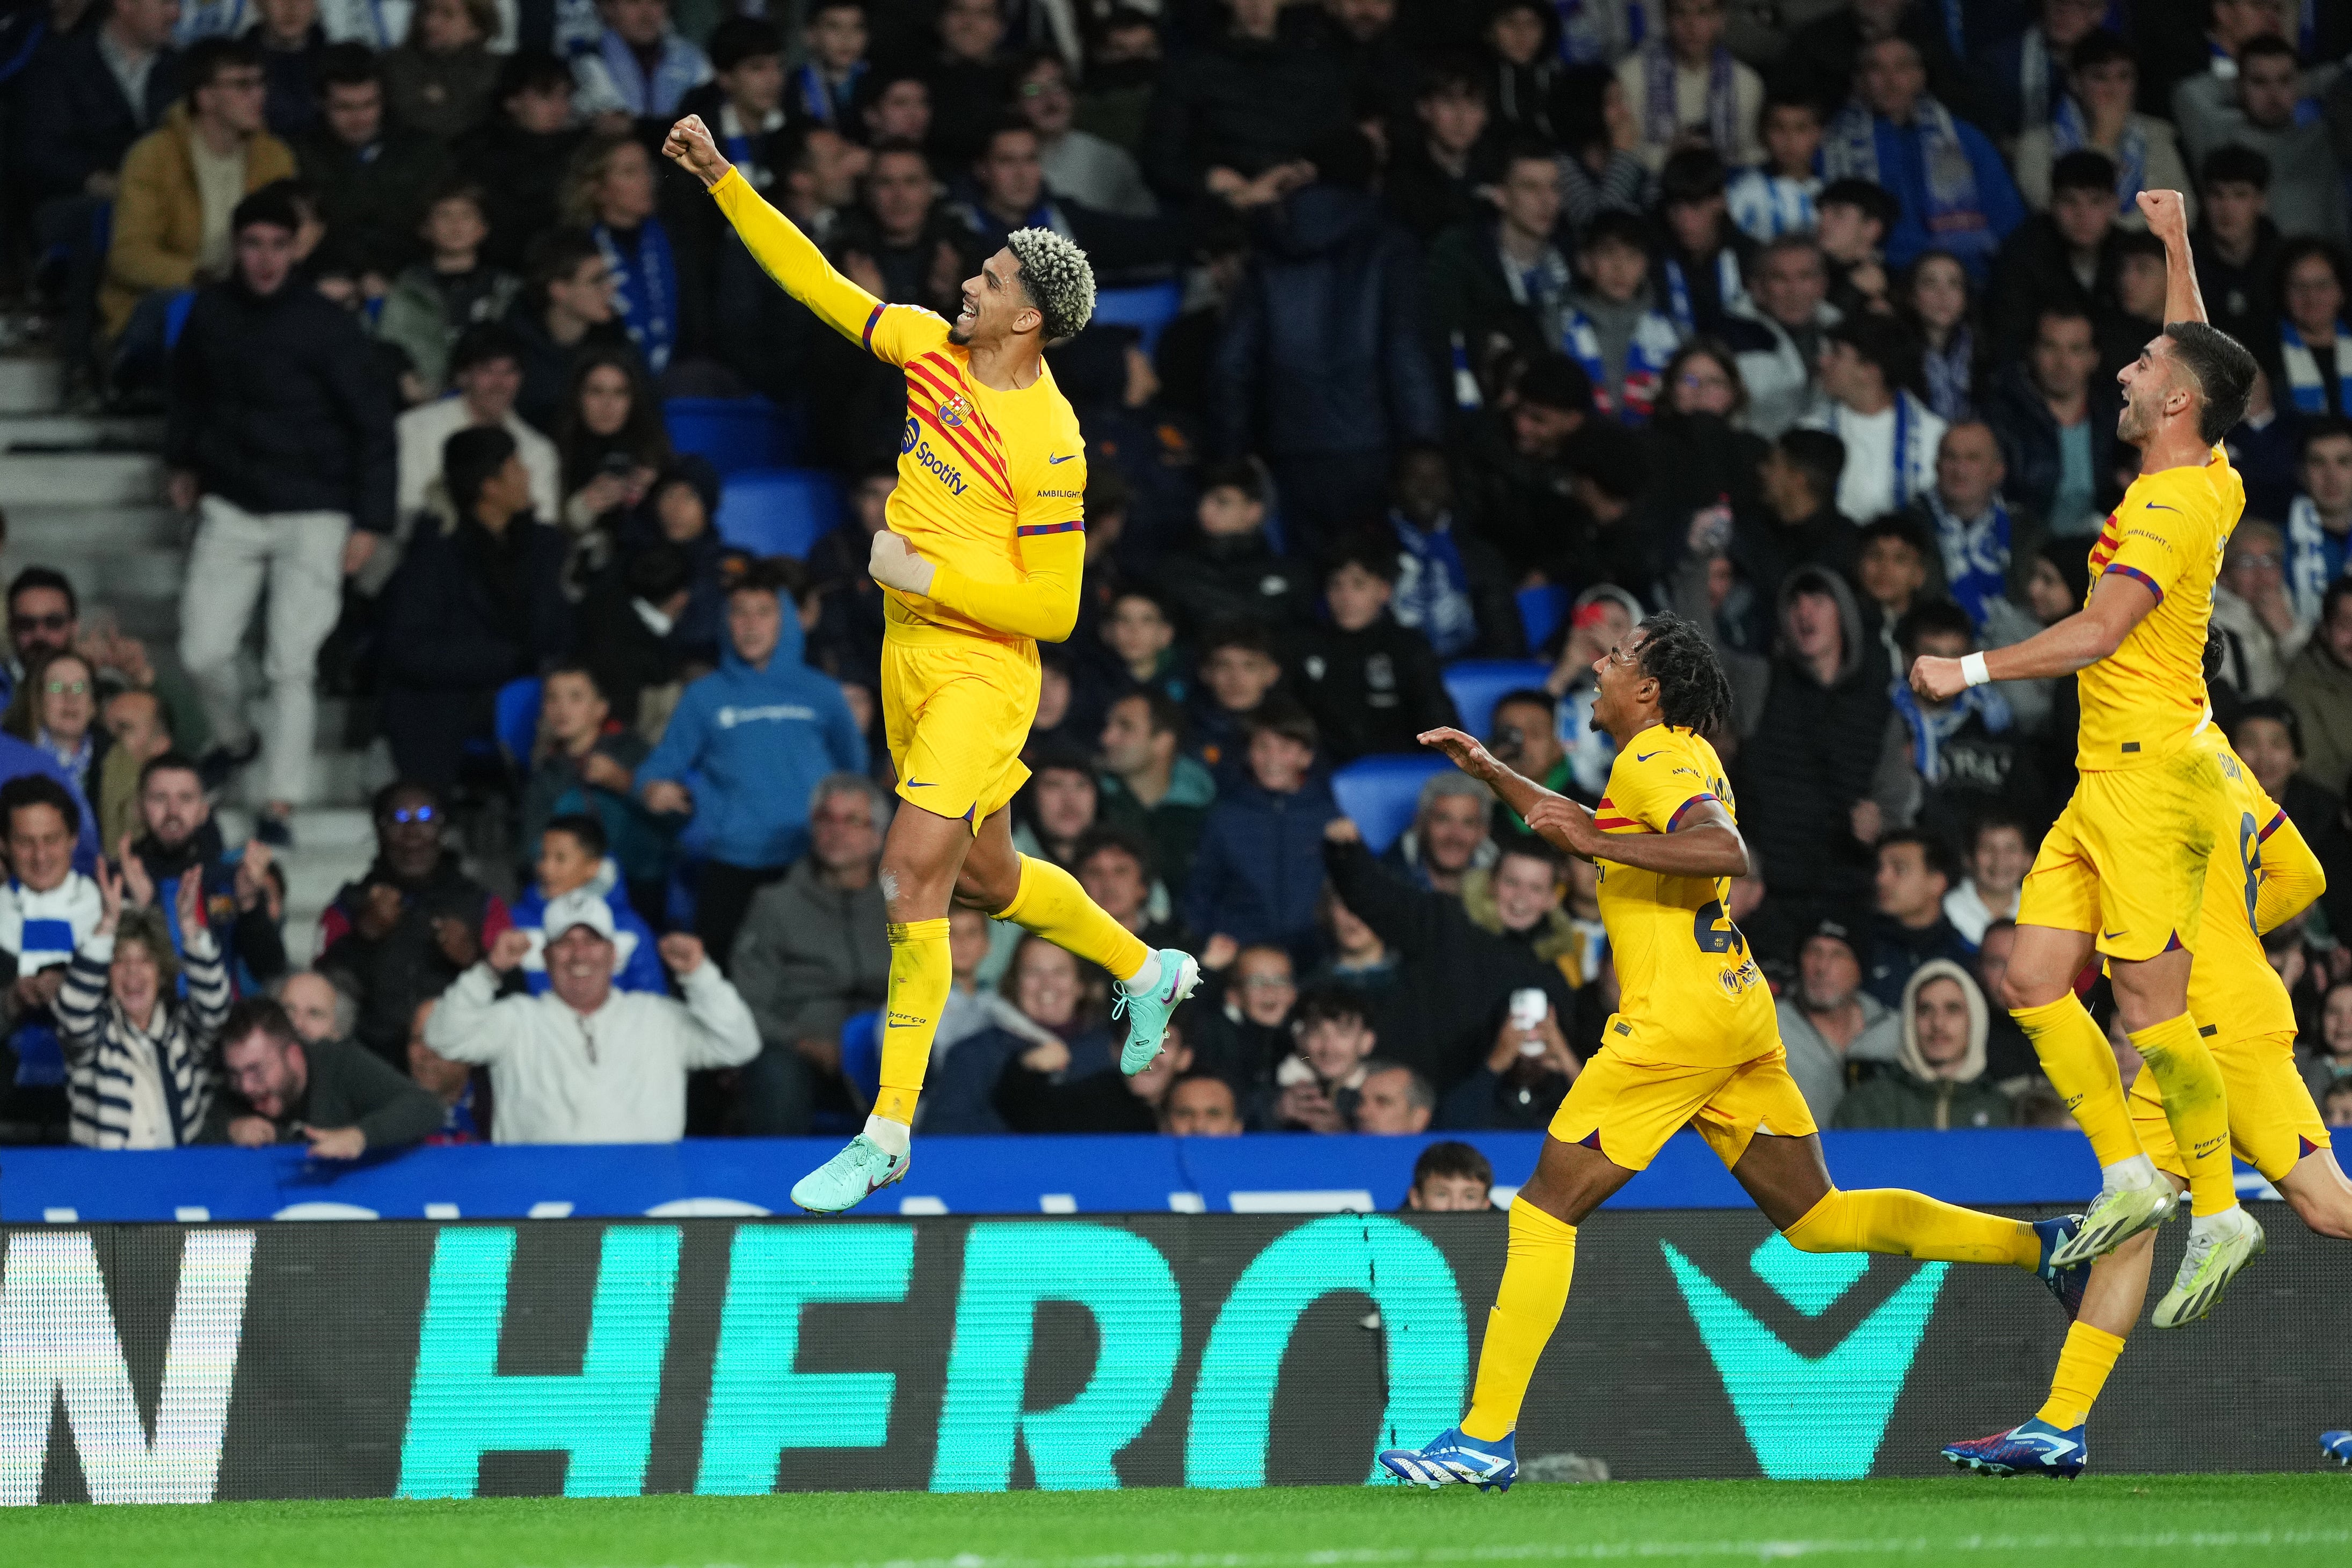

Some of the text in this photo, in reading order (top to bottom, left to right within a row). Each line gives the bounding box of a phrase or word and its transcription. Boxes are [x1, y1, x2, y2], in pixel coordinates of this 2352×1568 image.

[916, 441, 968, 495] Spotify
[1037, 490, 1080, 498] AMBILIGHT
[2125, 529, 2167, 546] MBILIGHT
[887, 1011, 926, 1024] barça
[2194, 1132, 2227, 1150] barça
